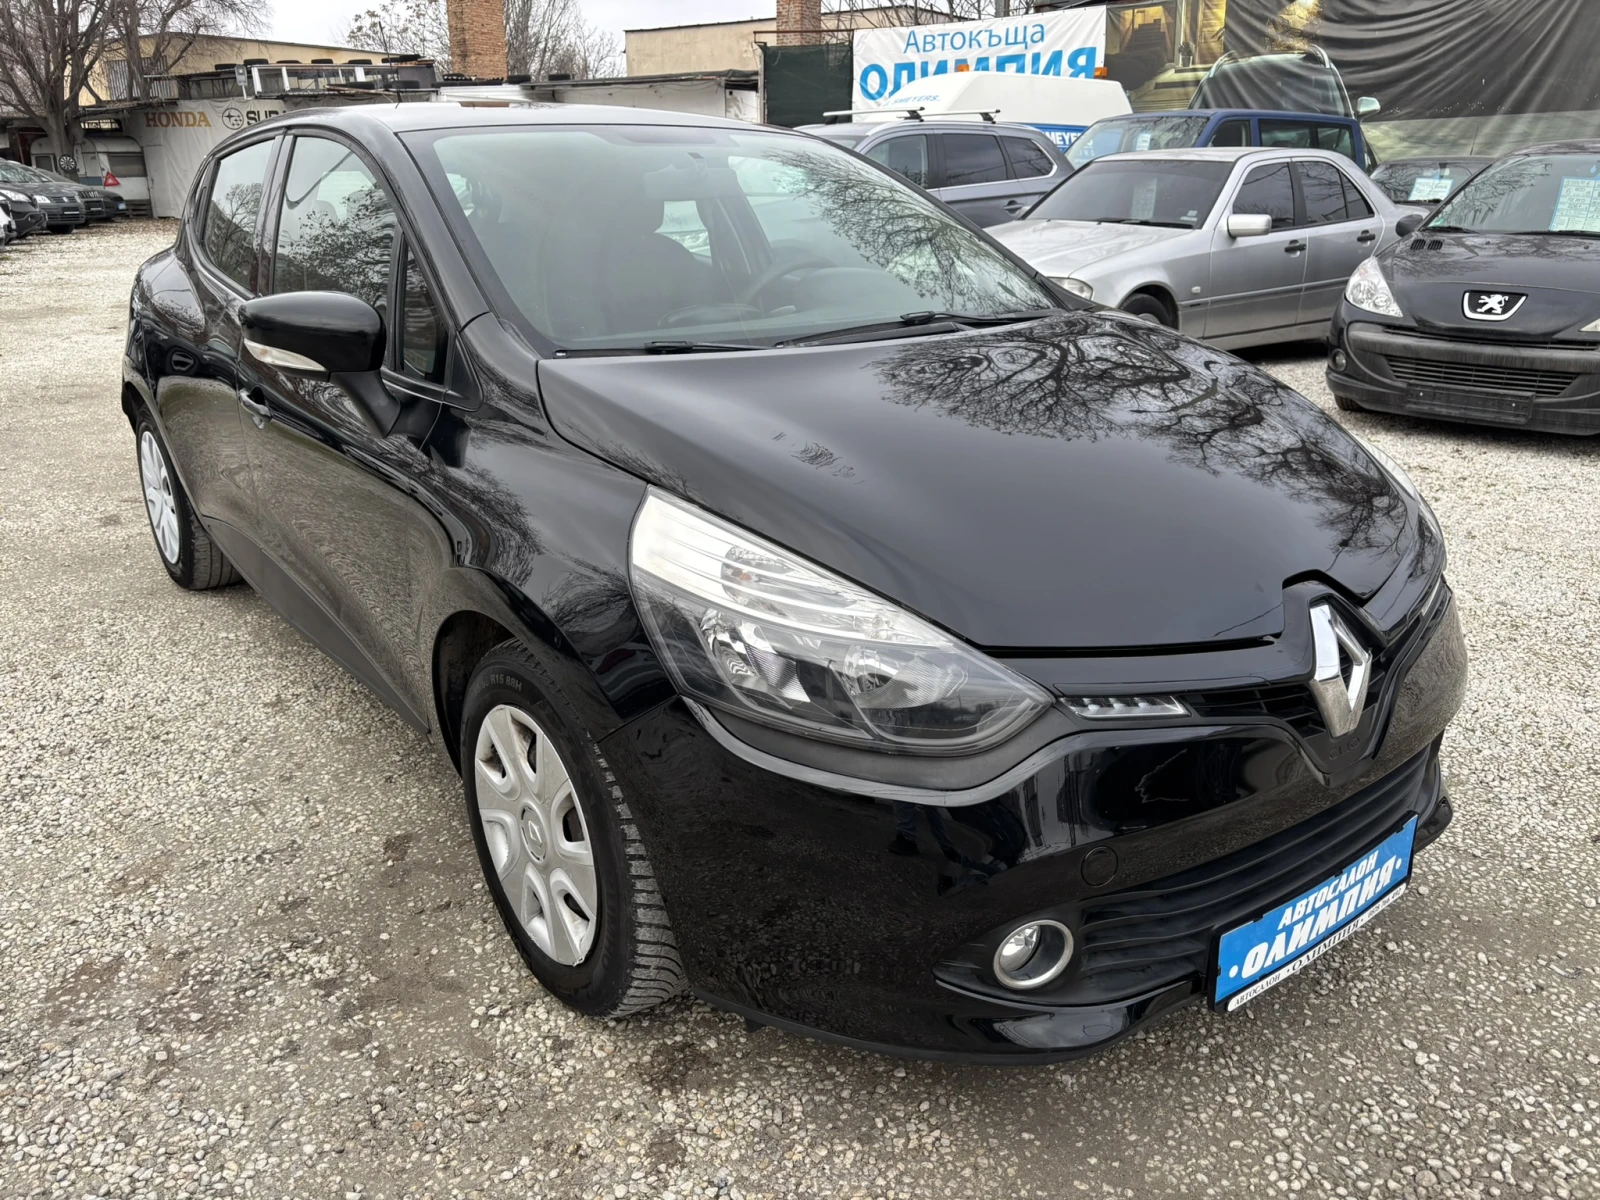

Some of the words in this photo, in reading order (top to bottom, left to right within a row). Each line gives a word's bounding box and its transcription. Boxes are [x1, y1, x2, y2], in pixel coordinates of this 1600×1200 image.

[903, 23, 1046, 54] Автокъща
[143, 111, 212, 128] HONDA
[490, 673, 505, 685] R15
[505, 675, 523, 692] 88H
[1277, 850, 1379, 930] АВТОСАЛОН
[1241, 854, 1397, 979] ОЛИМПИЯ
[1234, 973, 1281, 1006] АВТОСАЛОН
